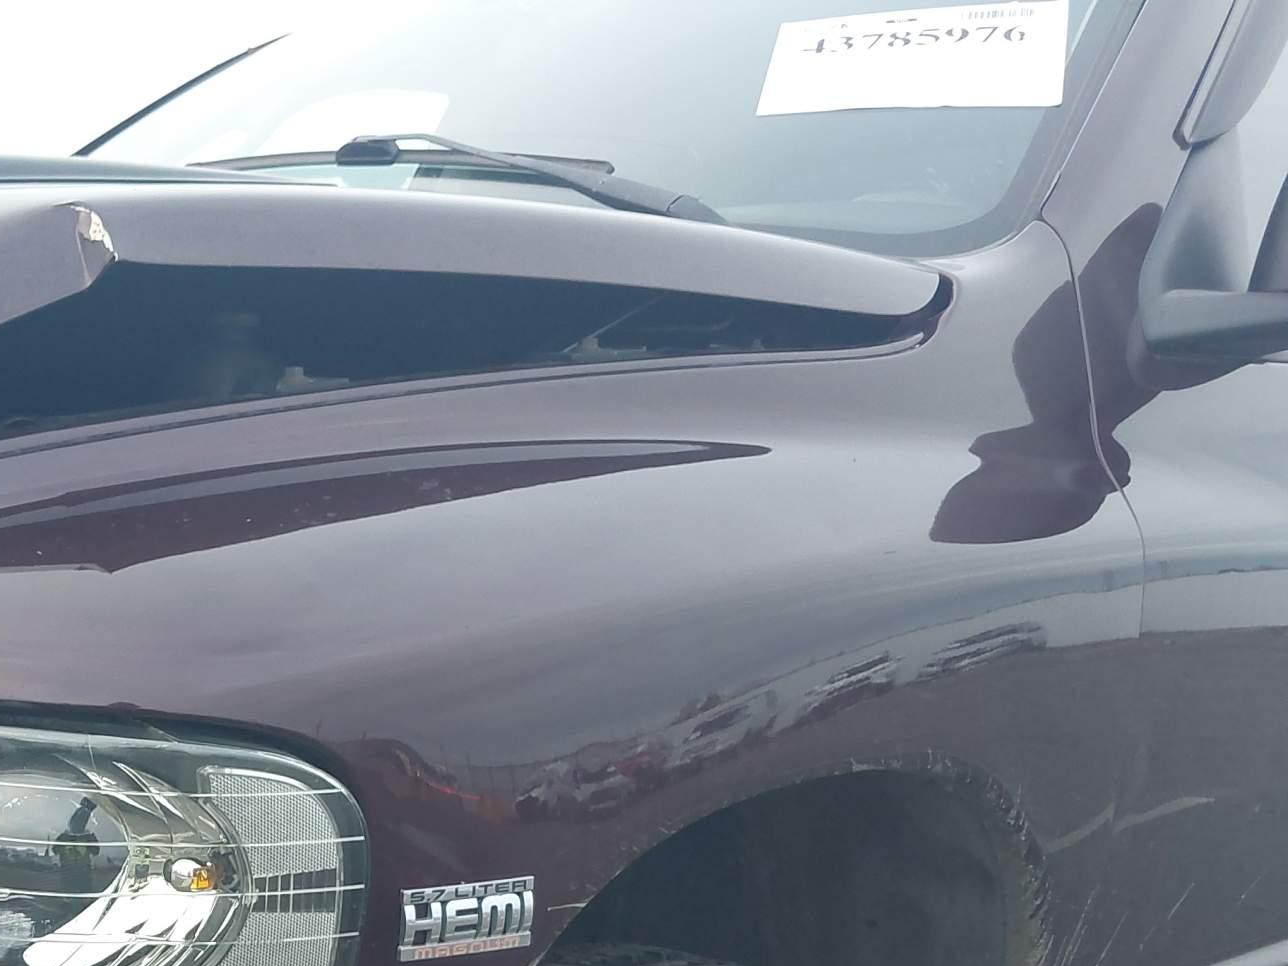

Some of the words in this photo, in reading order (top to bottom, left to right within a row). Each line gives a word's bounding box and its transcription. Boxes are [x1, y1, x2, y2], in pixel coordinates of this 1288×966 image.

[802, 25, 1026, 54] 43785976
[410, 889, 446, 904] 5.7
[454, 879, 527, 898] LITER
[404, 890, 534, 947] HEMI
